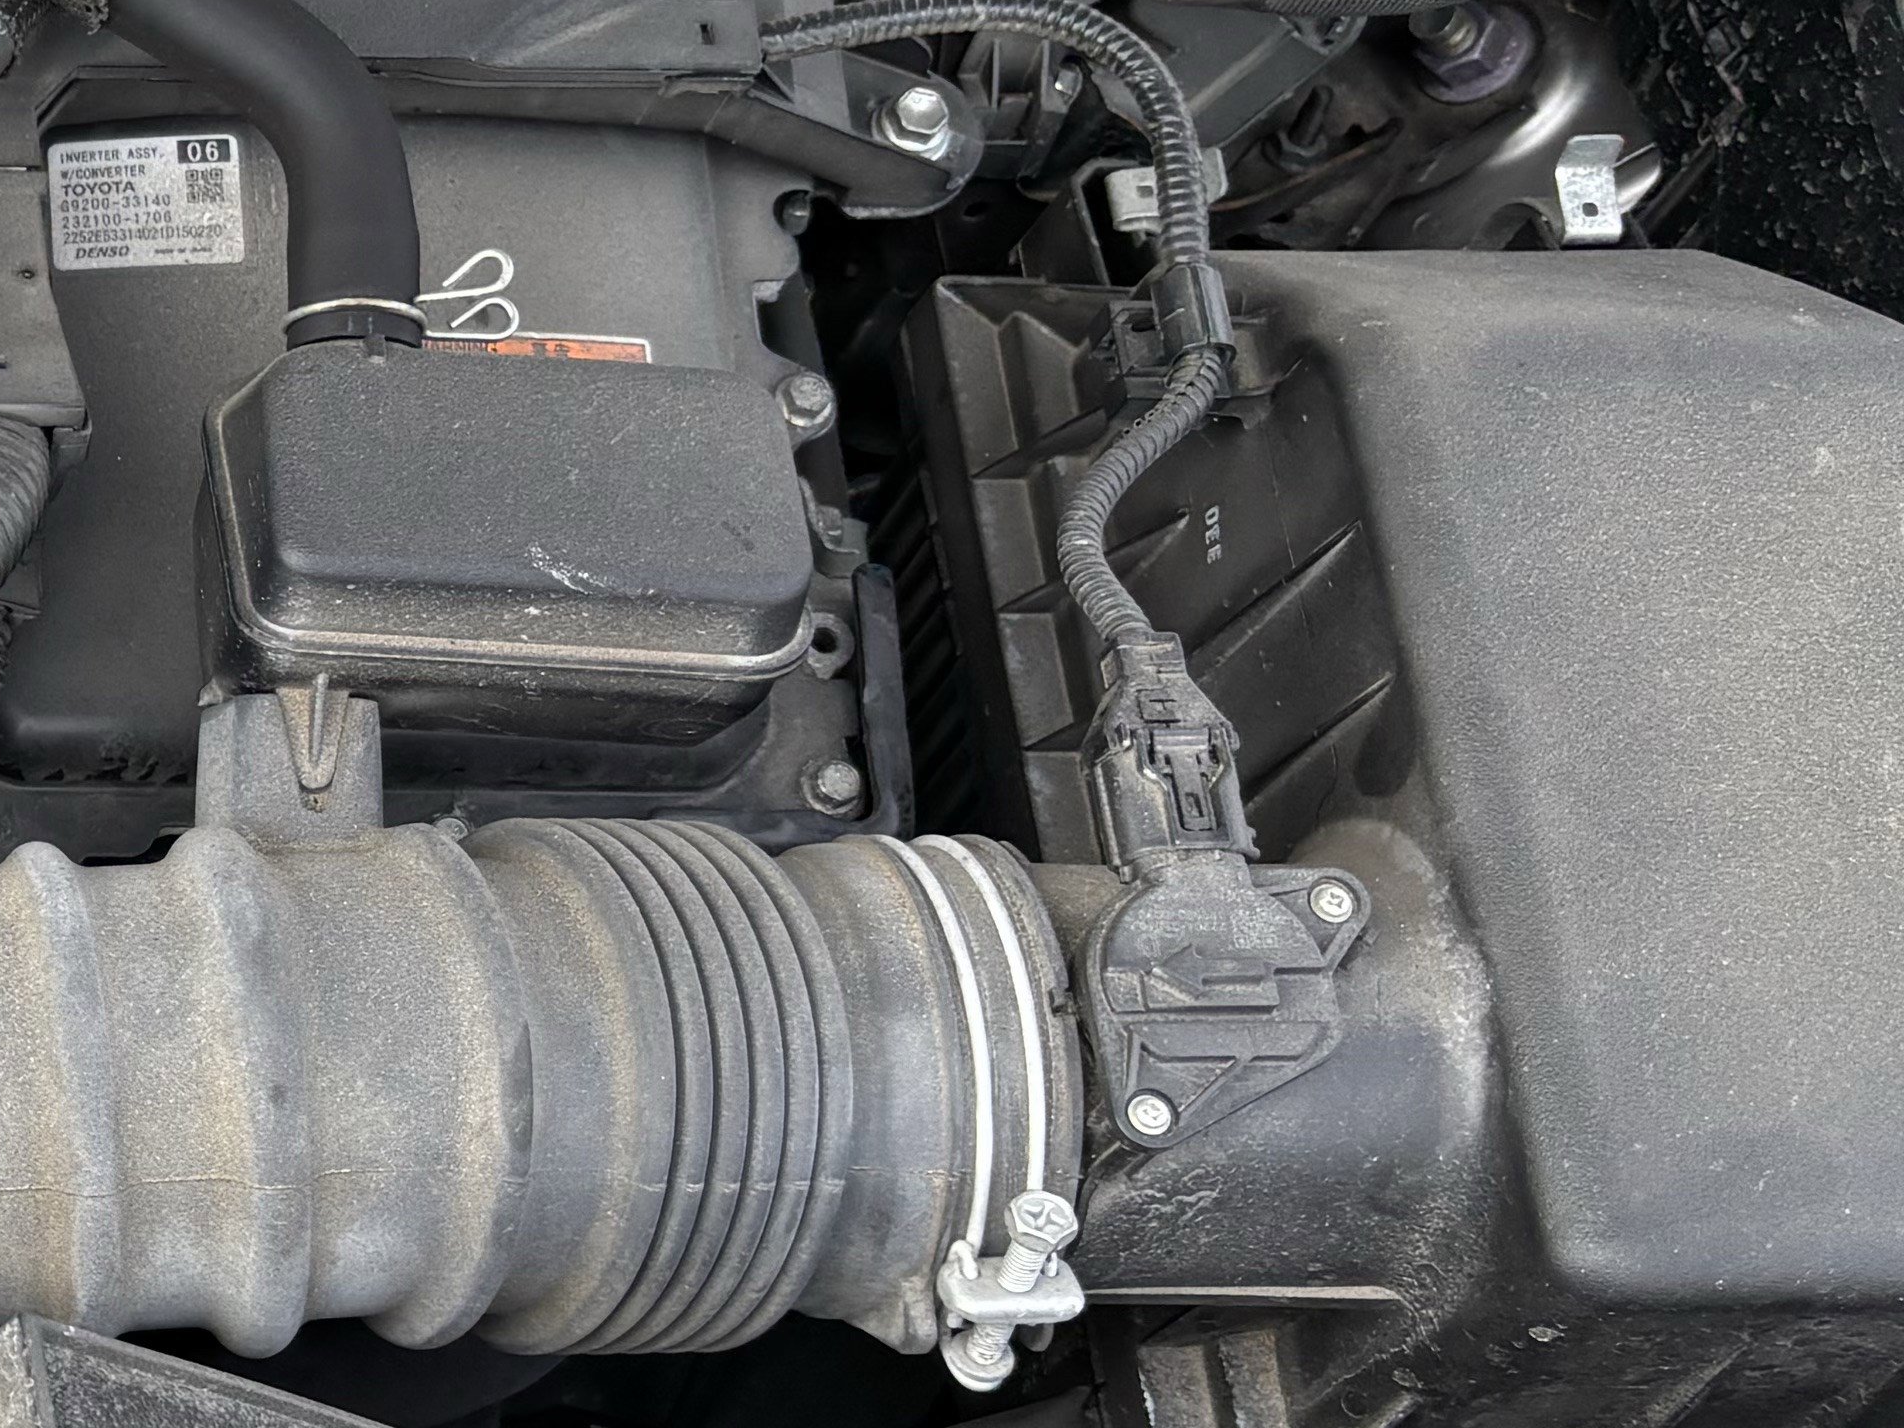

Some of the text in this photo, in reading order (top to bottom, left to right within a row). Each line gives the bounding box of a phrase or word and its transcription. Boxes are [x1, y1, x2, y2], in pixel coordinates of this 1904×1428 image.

[60, 150, 119, 164] INVERTER
[187, 141, 219, 161] 06
[60, 165, 146, 180] W/CONVERTER
[62, 181, 135, 197] TOYOTA
[60, 194, 171, 213] G9200-33140
[75, 245, 130, 260] DENSO
